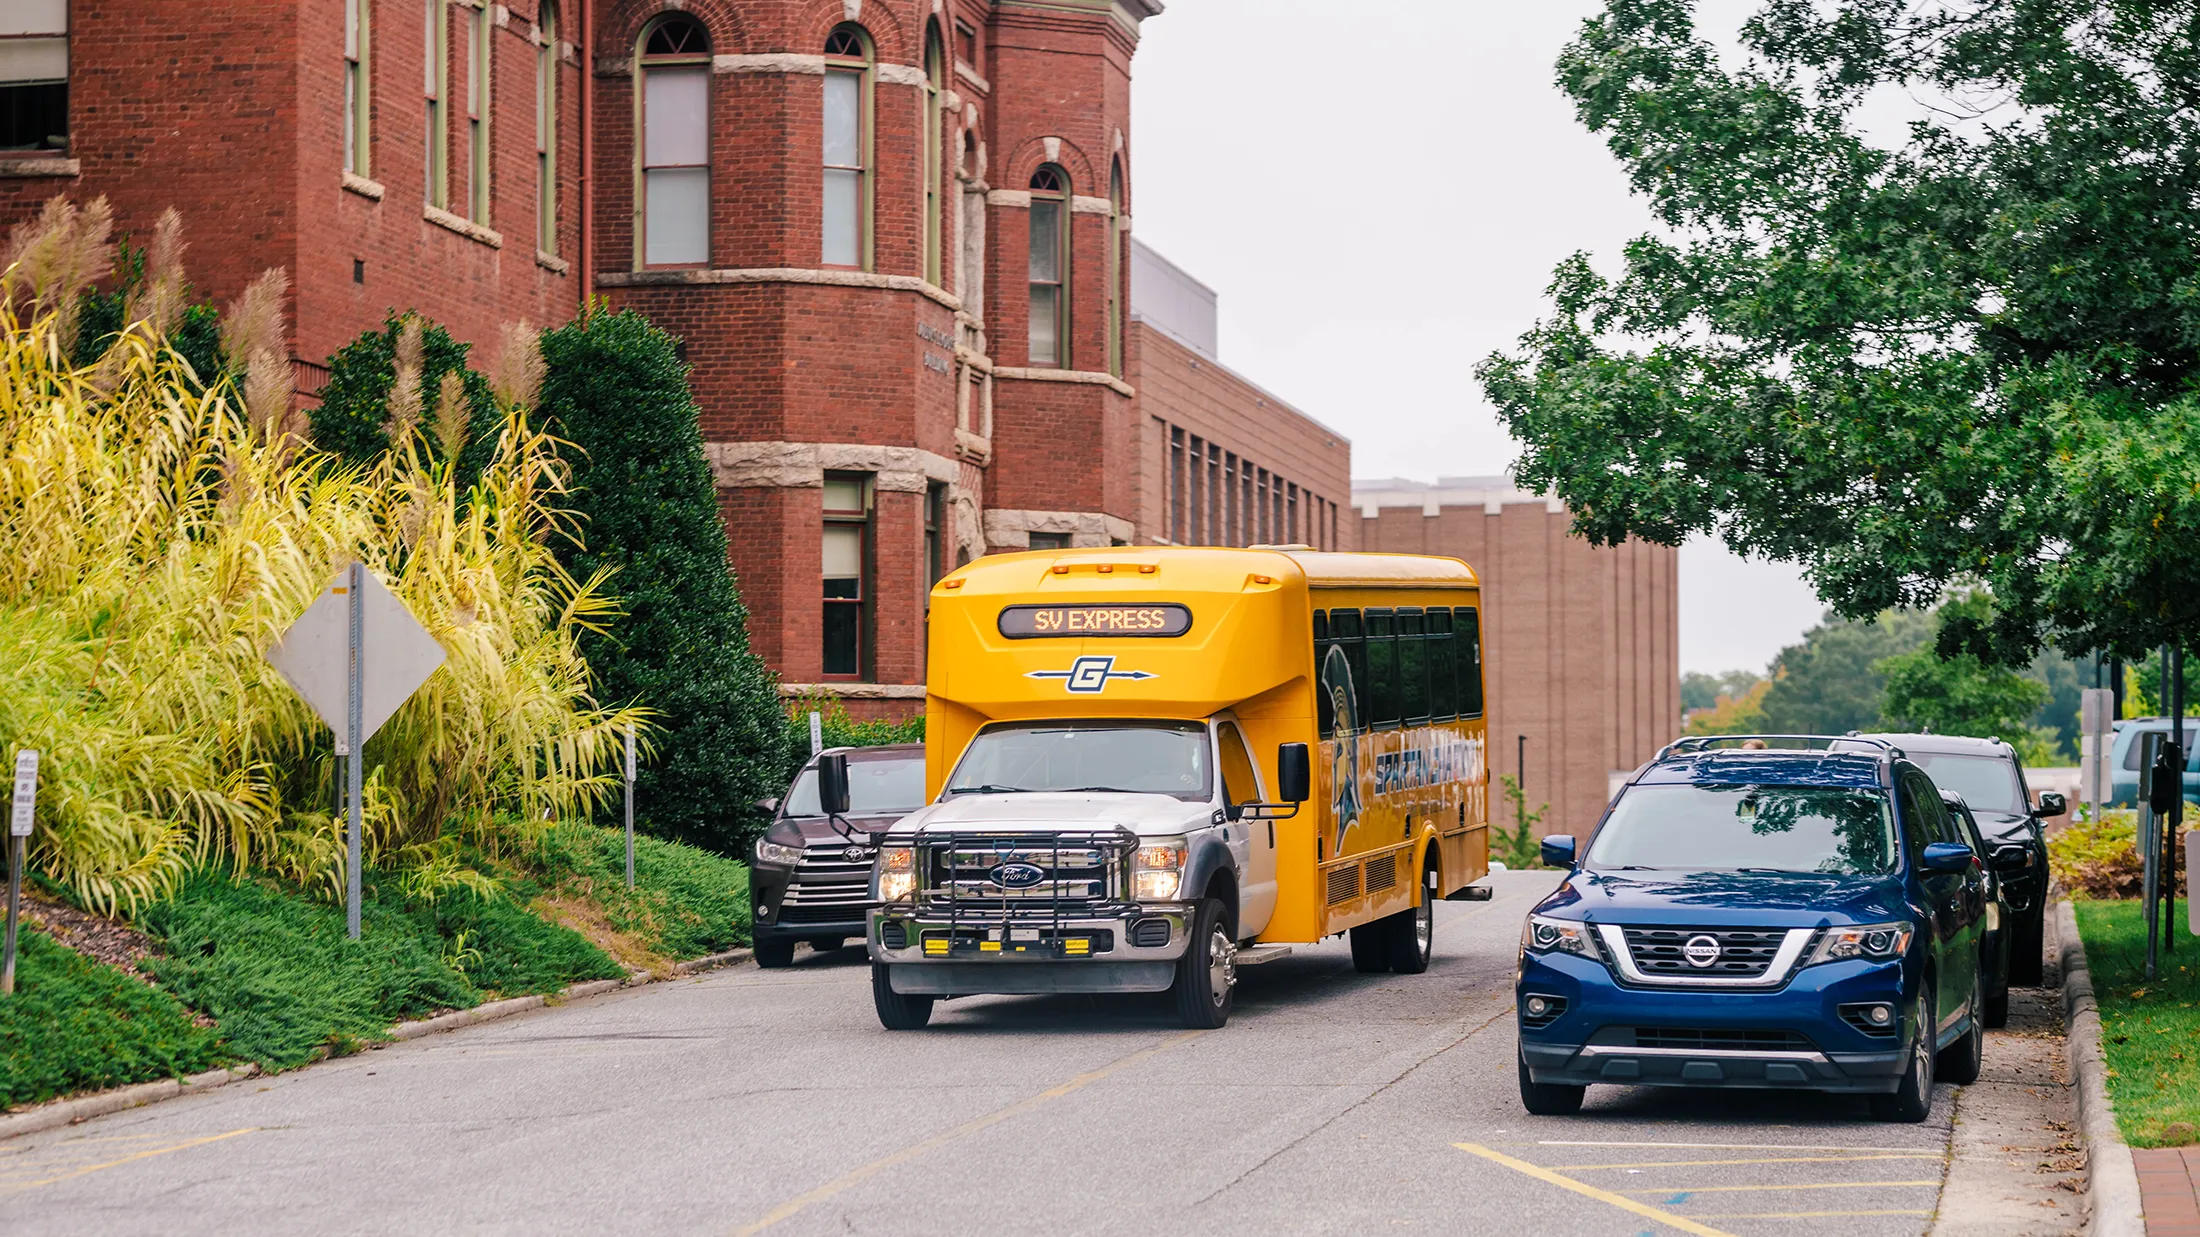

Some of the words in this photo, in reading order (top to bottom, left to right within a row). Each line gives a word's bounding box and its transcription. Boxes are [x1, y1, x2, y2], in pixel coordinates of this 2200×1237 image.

[1034, 609, 1064, 630] SV
[1068, 609, 1166, 631] EXPRESS
[1067, 657, 1114, 692] G
[1375, 746, 1431, 796] SPARTAN
[1001, 867, 1031, 880] Ford
